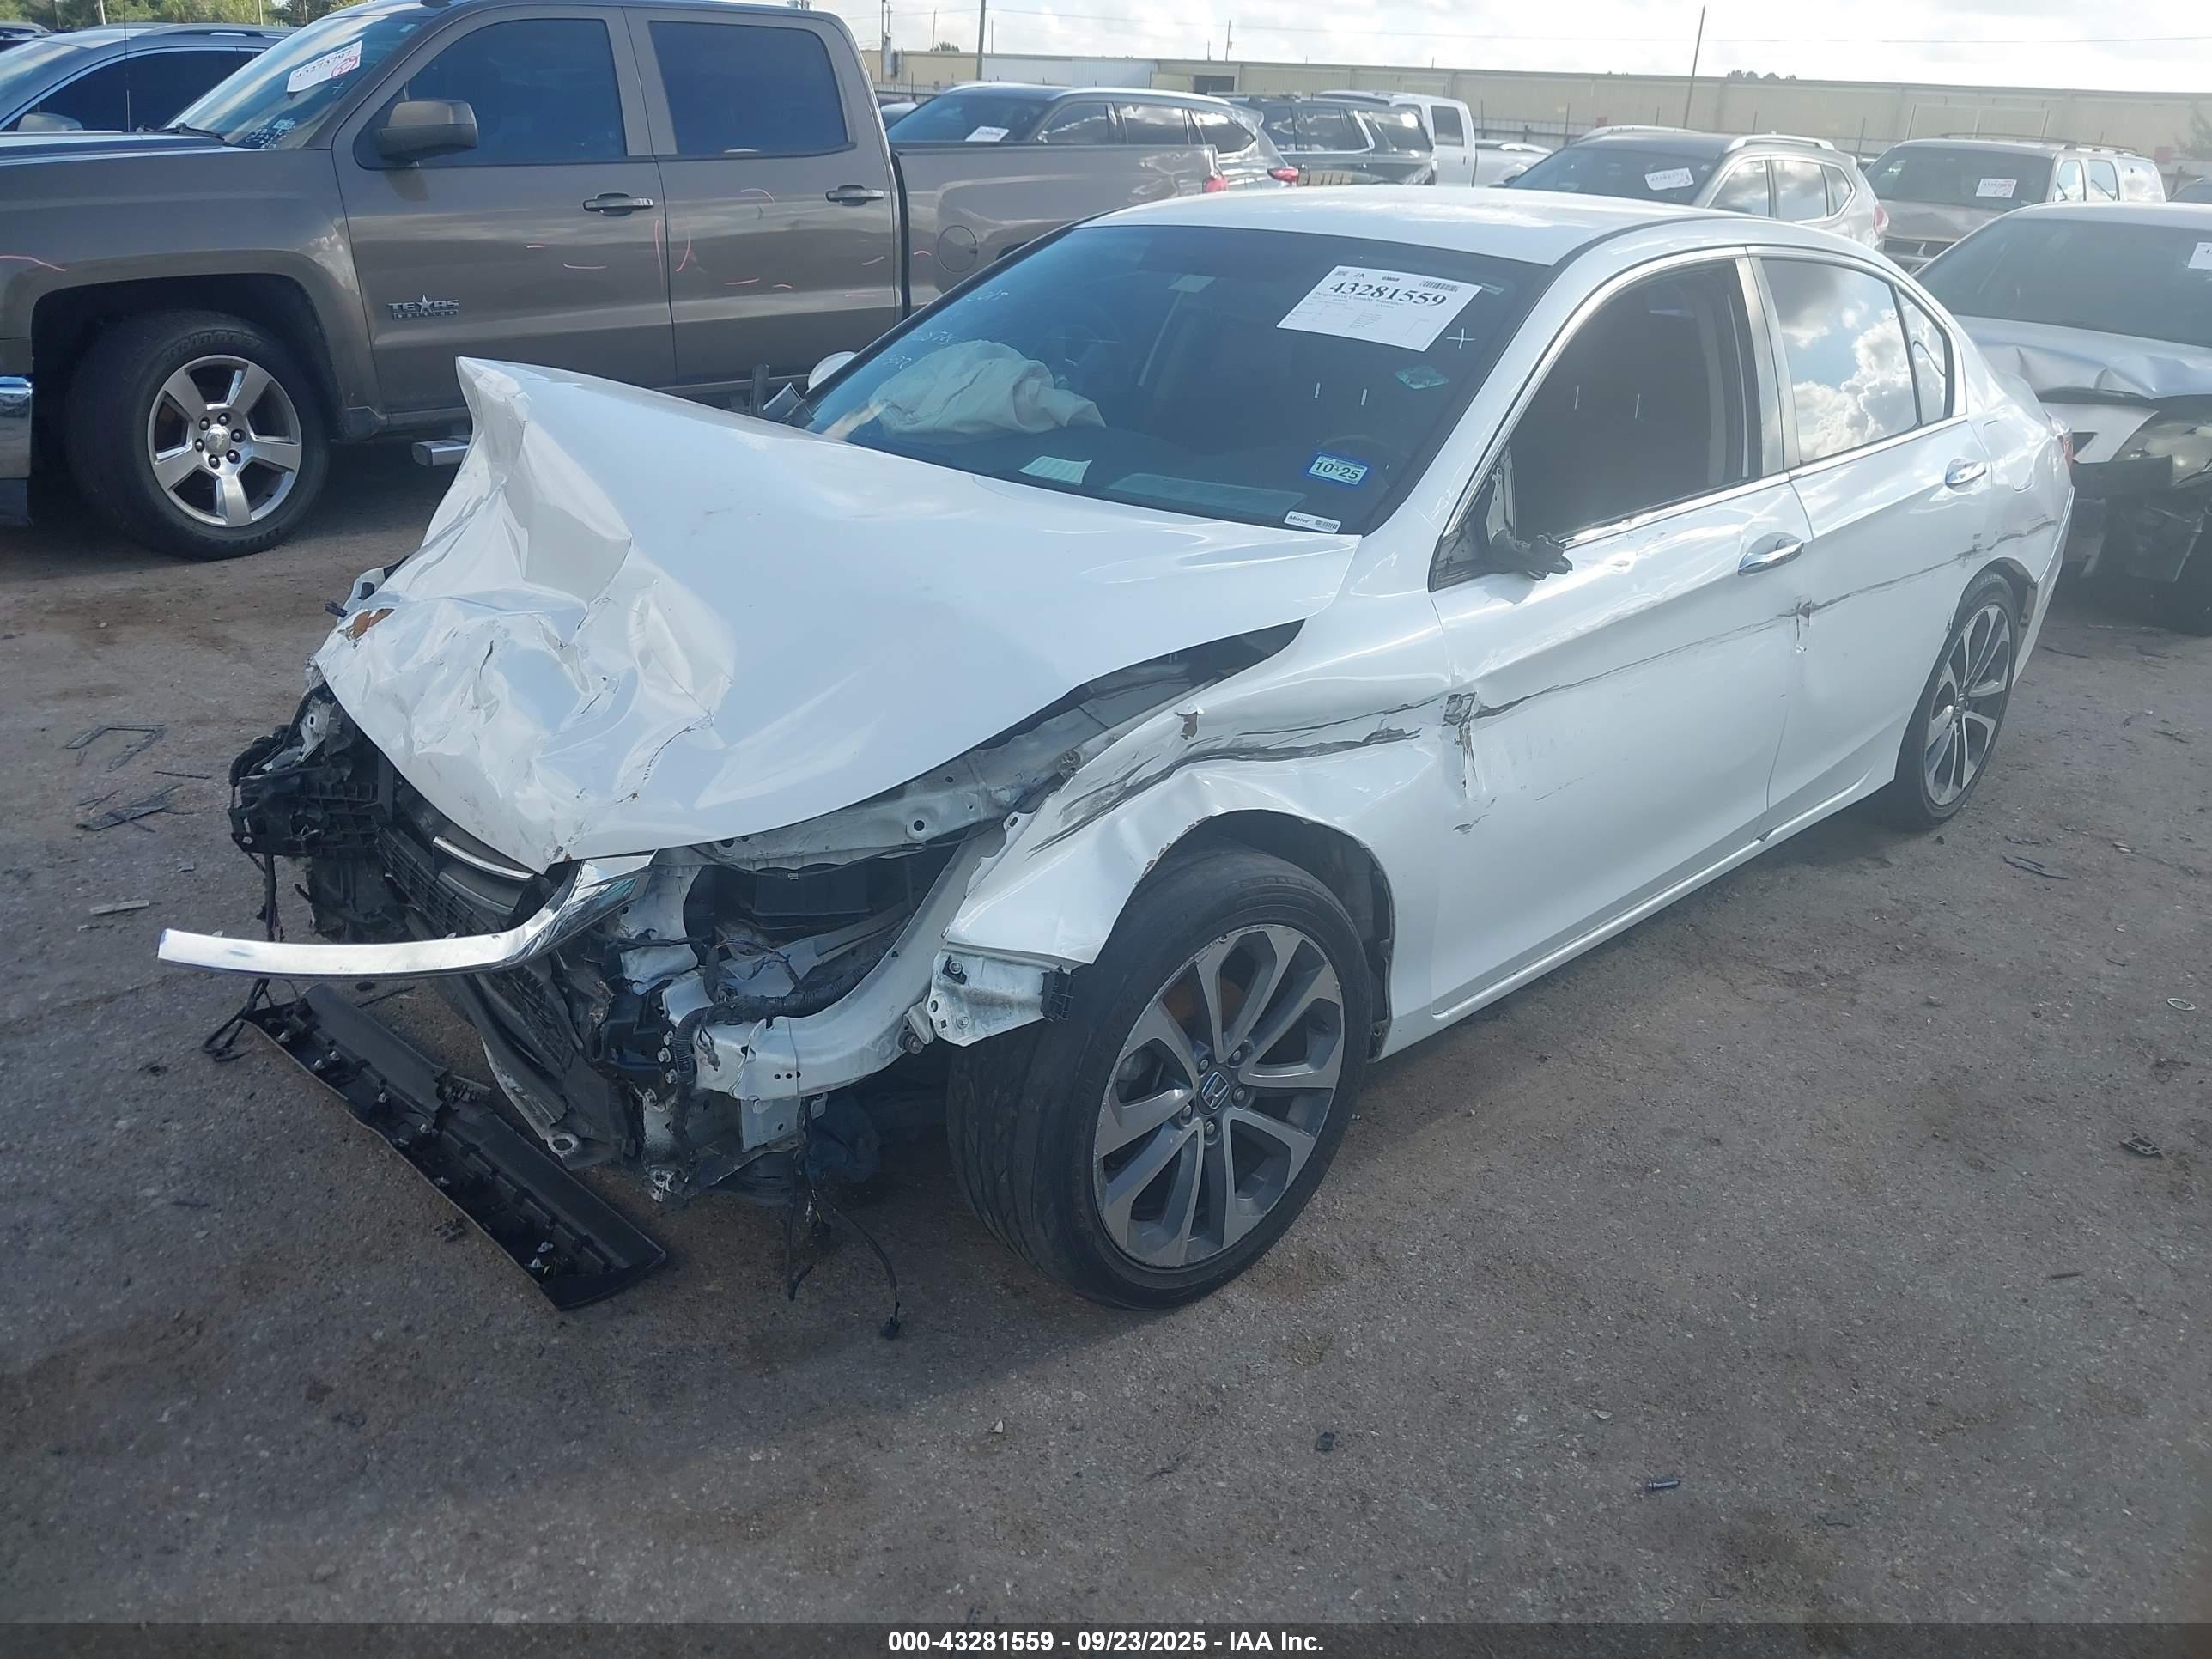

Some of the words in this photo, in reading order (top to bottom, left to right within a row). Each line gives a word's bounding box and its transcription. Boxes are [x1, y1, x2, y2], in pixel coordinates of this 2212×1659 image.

[1328, 281, 1447, 307] 43281559
[387, 295, 460, 313] TEXAS
[1316, 461, 1334, 473] 10
[1338, 467, 1360, 479] 25
